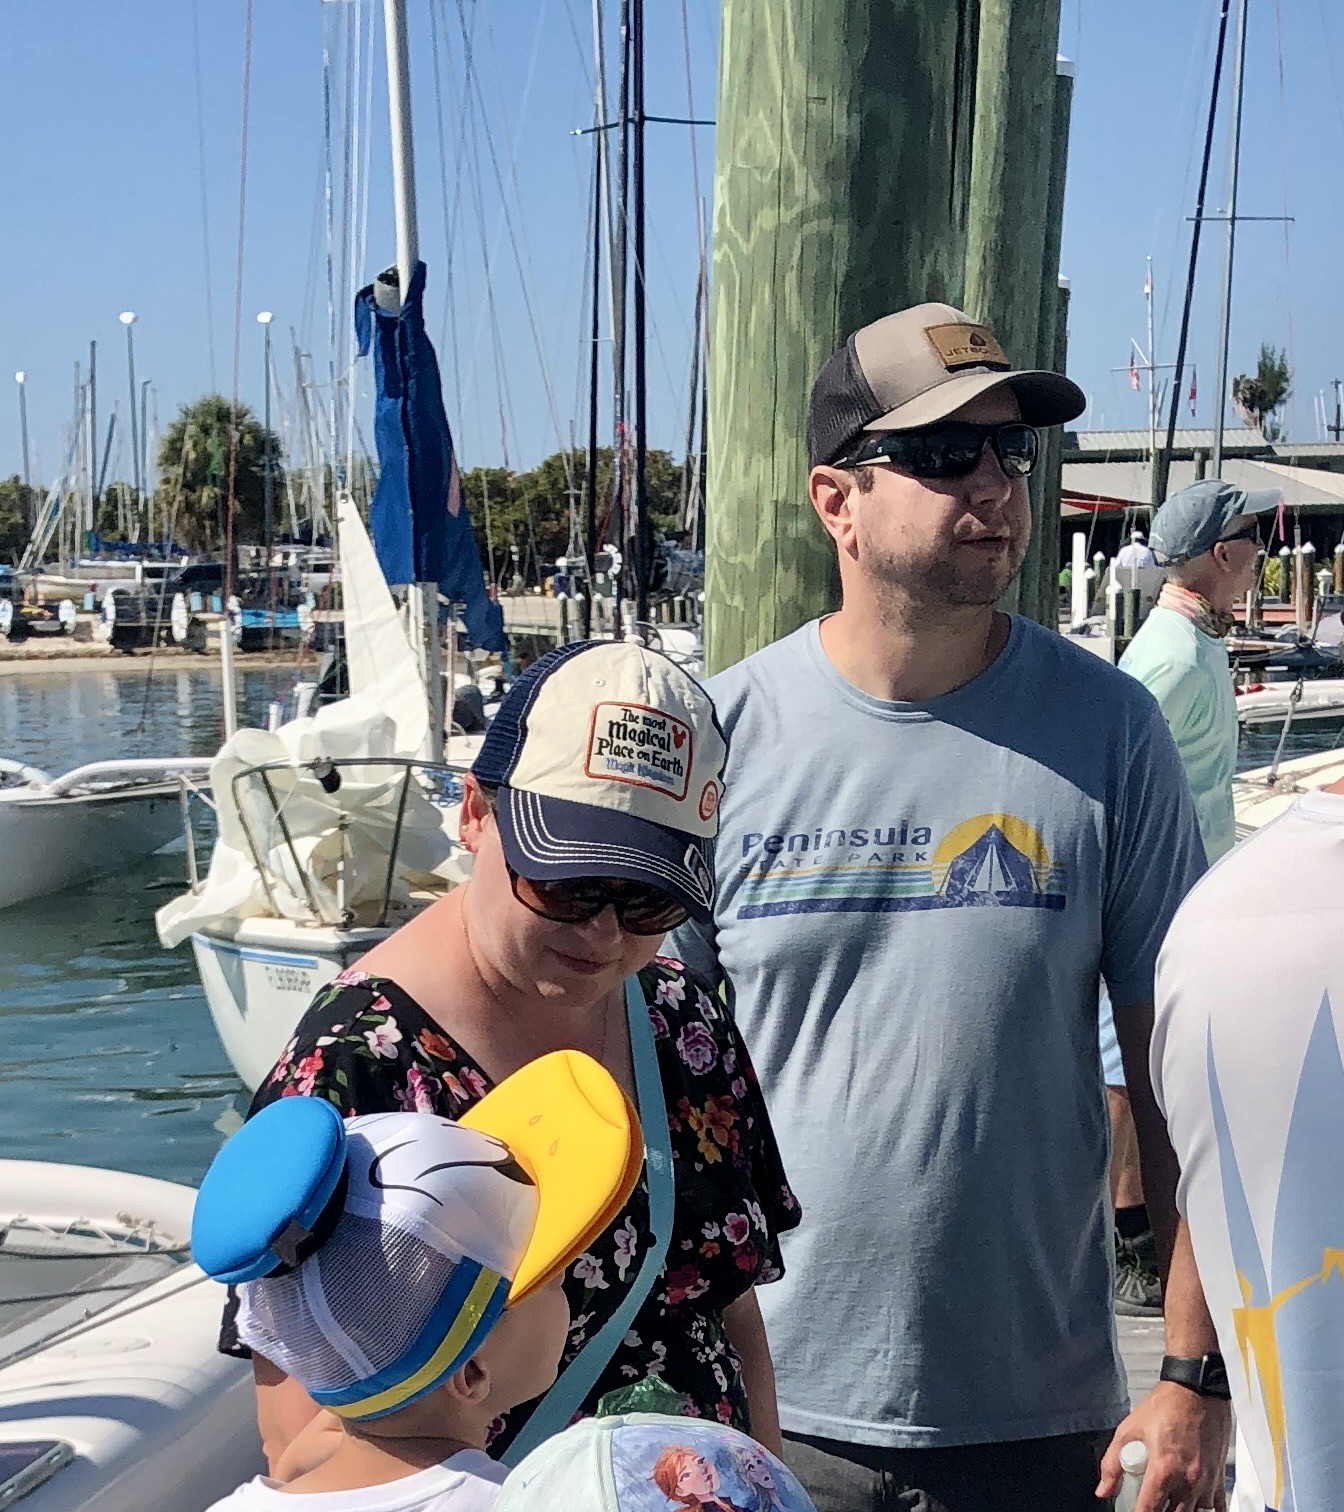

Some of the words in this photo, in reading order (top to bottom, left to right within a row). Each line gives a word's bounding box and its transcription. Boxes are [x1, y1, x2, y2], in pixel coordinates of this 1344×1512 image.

[621, 708, 640, 724] The
[642, 716, 666, 731] most
[608, 720, 670, 752] Magical
[594, 737, 634, 759] Place
[637, 751, 650, 762] on
[651, 750, 683, 777] Earth
[742, 822, 932, 857] Peninsula
[739, 855, 824, 874] STATE
[847, 852, 928, 863] PARK
